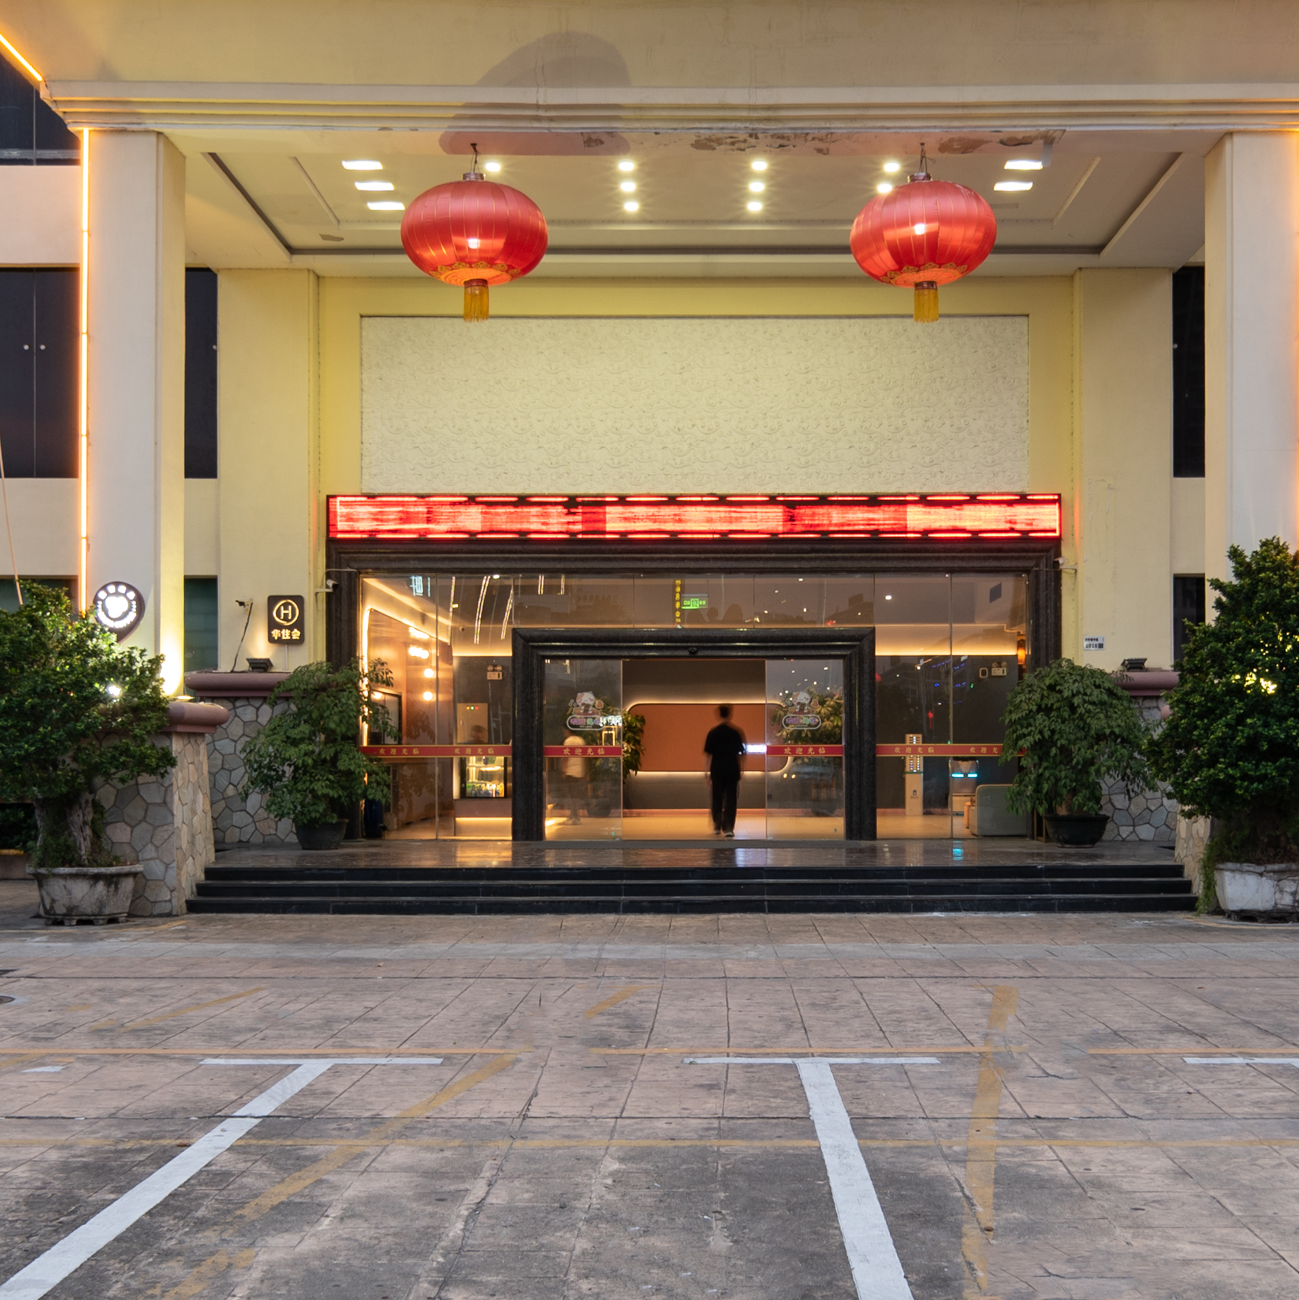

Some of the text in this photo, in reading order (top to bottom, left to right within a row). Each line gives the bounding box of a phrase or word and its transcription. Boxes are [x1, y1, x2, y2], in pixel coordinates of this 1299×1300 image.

[271, 628, 301, 640] 华住会
[563, 747, 605, 756] 欢迎光临
[784, 746, 826, 755] 欢迎光临
